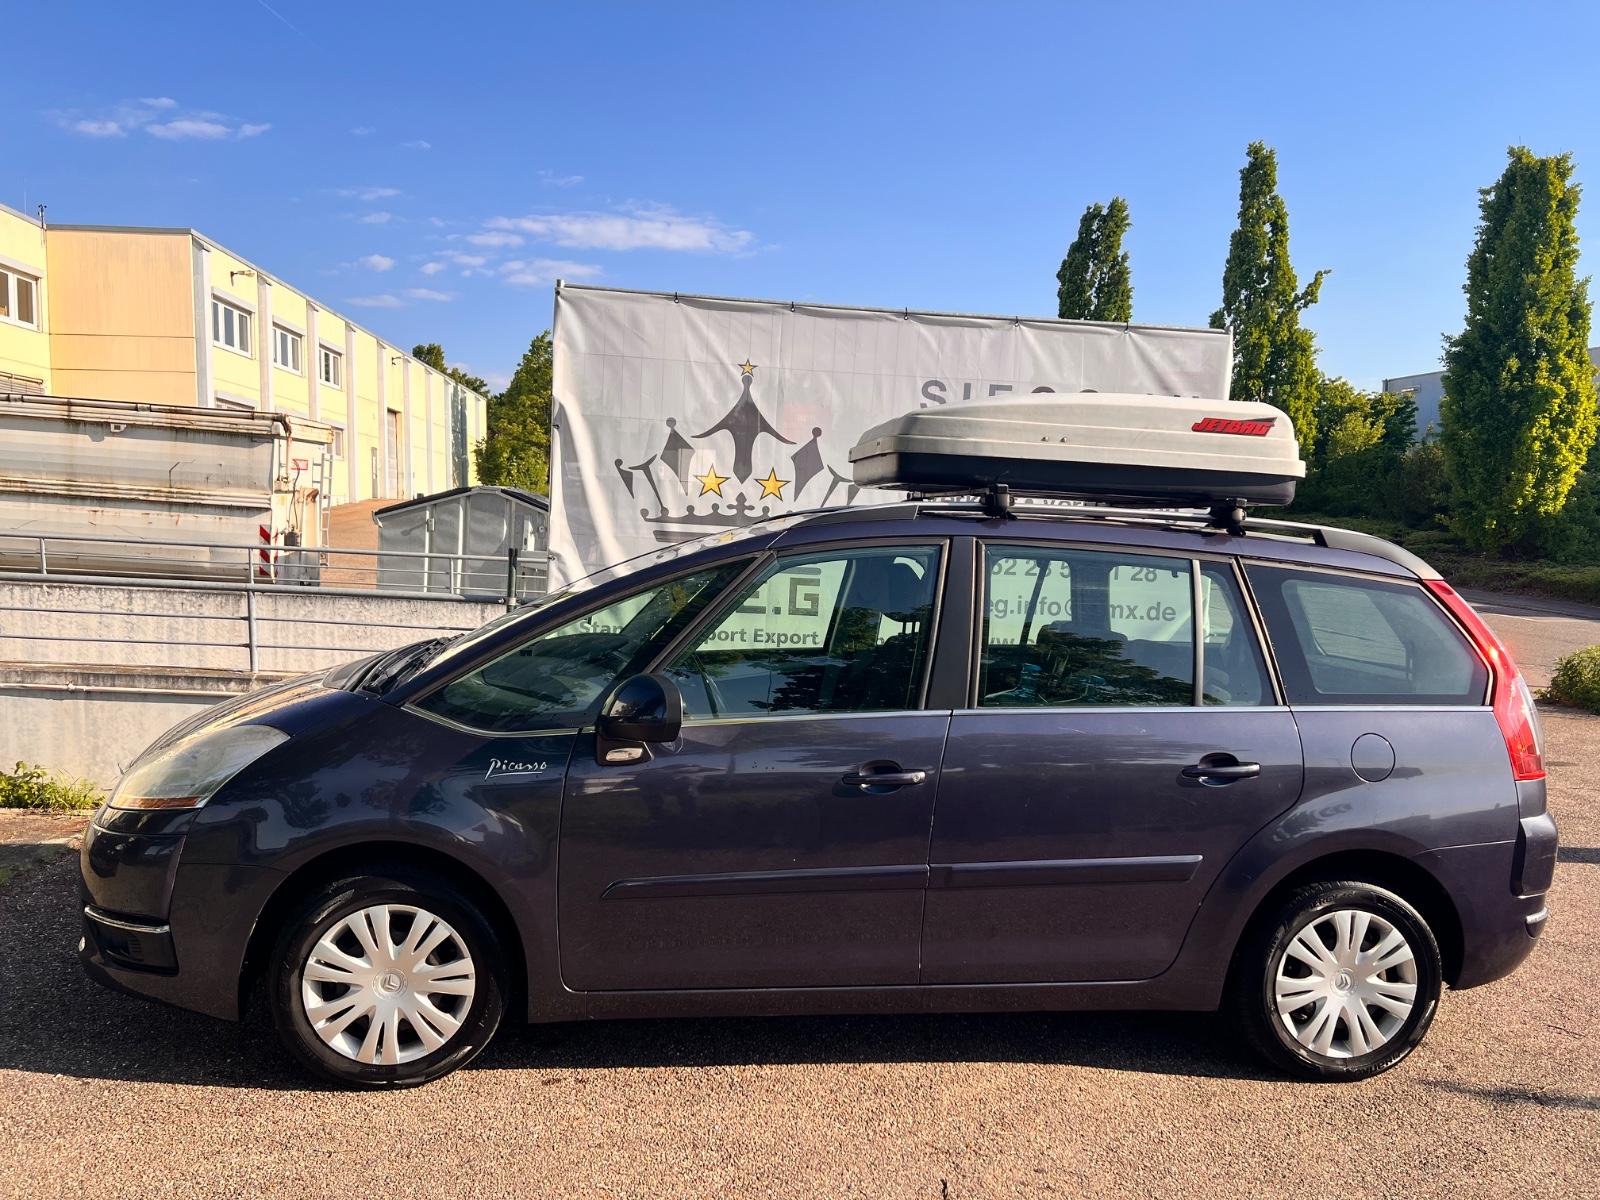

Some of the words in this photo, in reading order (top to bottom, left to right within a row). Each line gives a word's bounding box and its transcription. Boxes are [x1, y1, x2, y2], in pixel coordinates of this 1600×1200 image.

[1192, 417, 1276, 437] JETBAG
[579, 621, 624, 634] Stan
[704, 628, 747, 645] port
[753, 628, 821, 647] Export
[485, 758, 548, 780] Picasso
